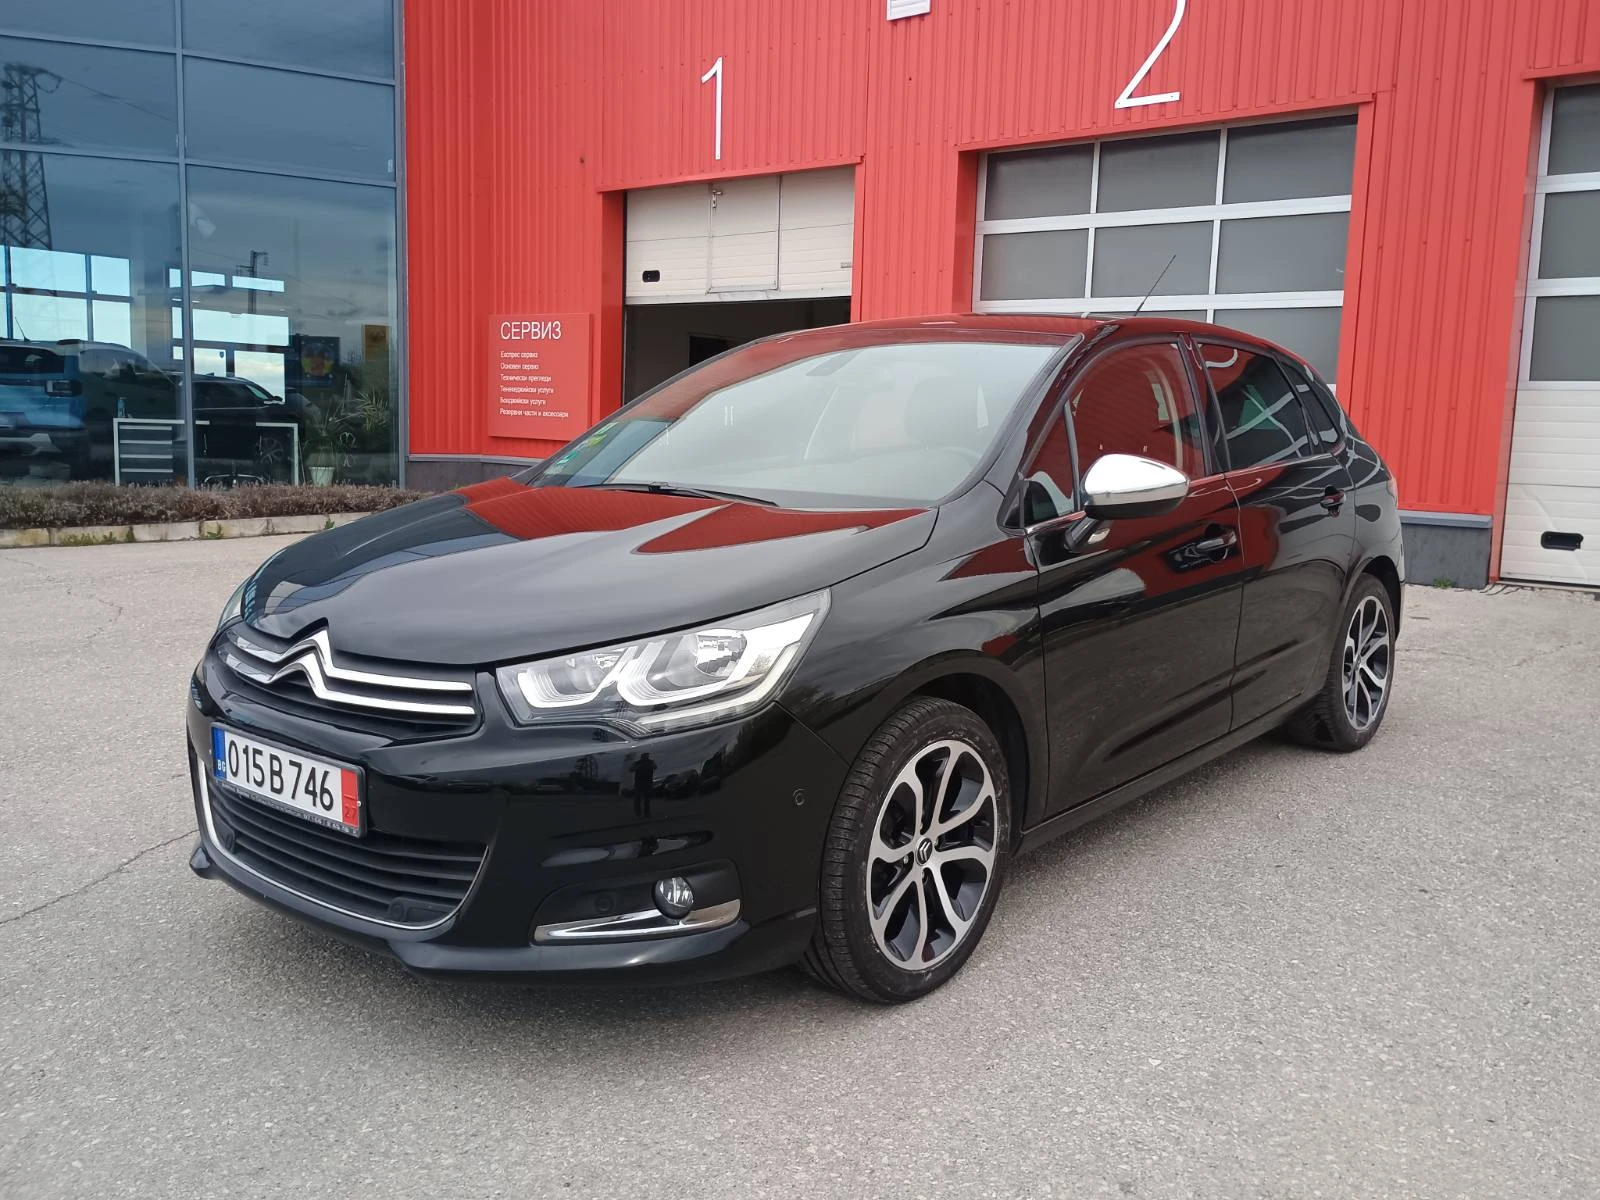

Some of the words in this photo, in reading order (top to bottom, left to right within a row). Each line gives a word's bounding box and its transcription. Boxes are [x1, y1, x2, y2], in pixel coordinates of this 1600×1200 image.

[1114, 0, 1186, 109] 2
[701, 56, 723, 160] 1
[500, 320, 562, 340] СЕРВИЗ
[217, 759, 226, 772] BG
